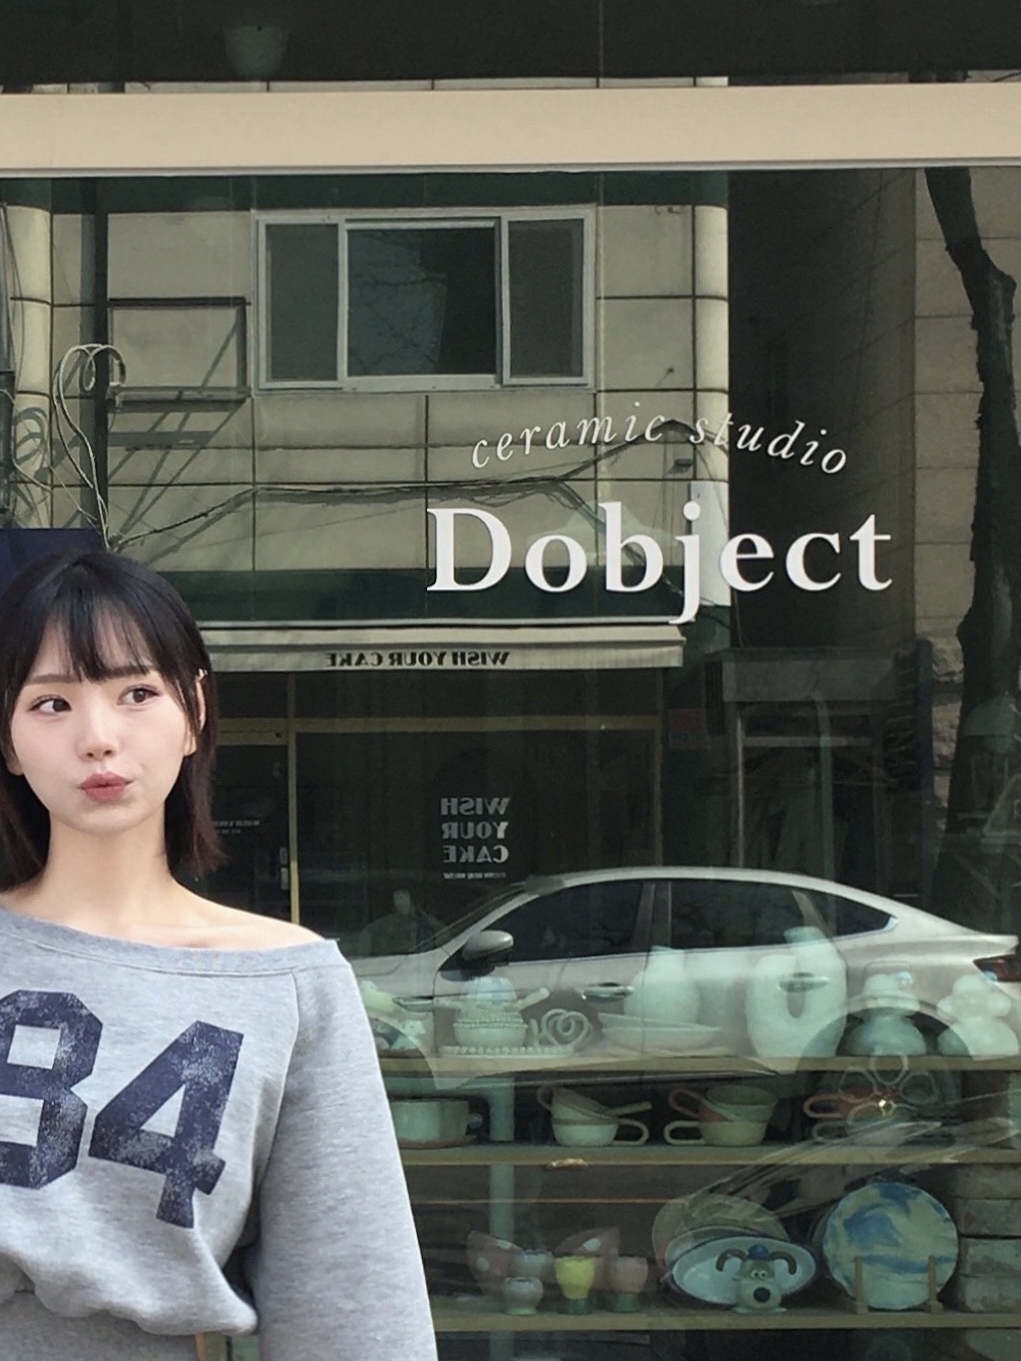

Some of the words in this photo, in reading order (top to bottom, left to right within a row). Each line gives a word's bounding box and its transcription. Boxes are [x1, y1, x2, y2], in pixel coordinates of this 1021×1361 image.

[471, 401, 666, 469] ceramic
[689, 411, 848, 475] studio
[426, 500, 893, 625] Dobject
